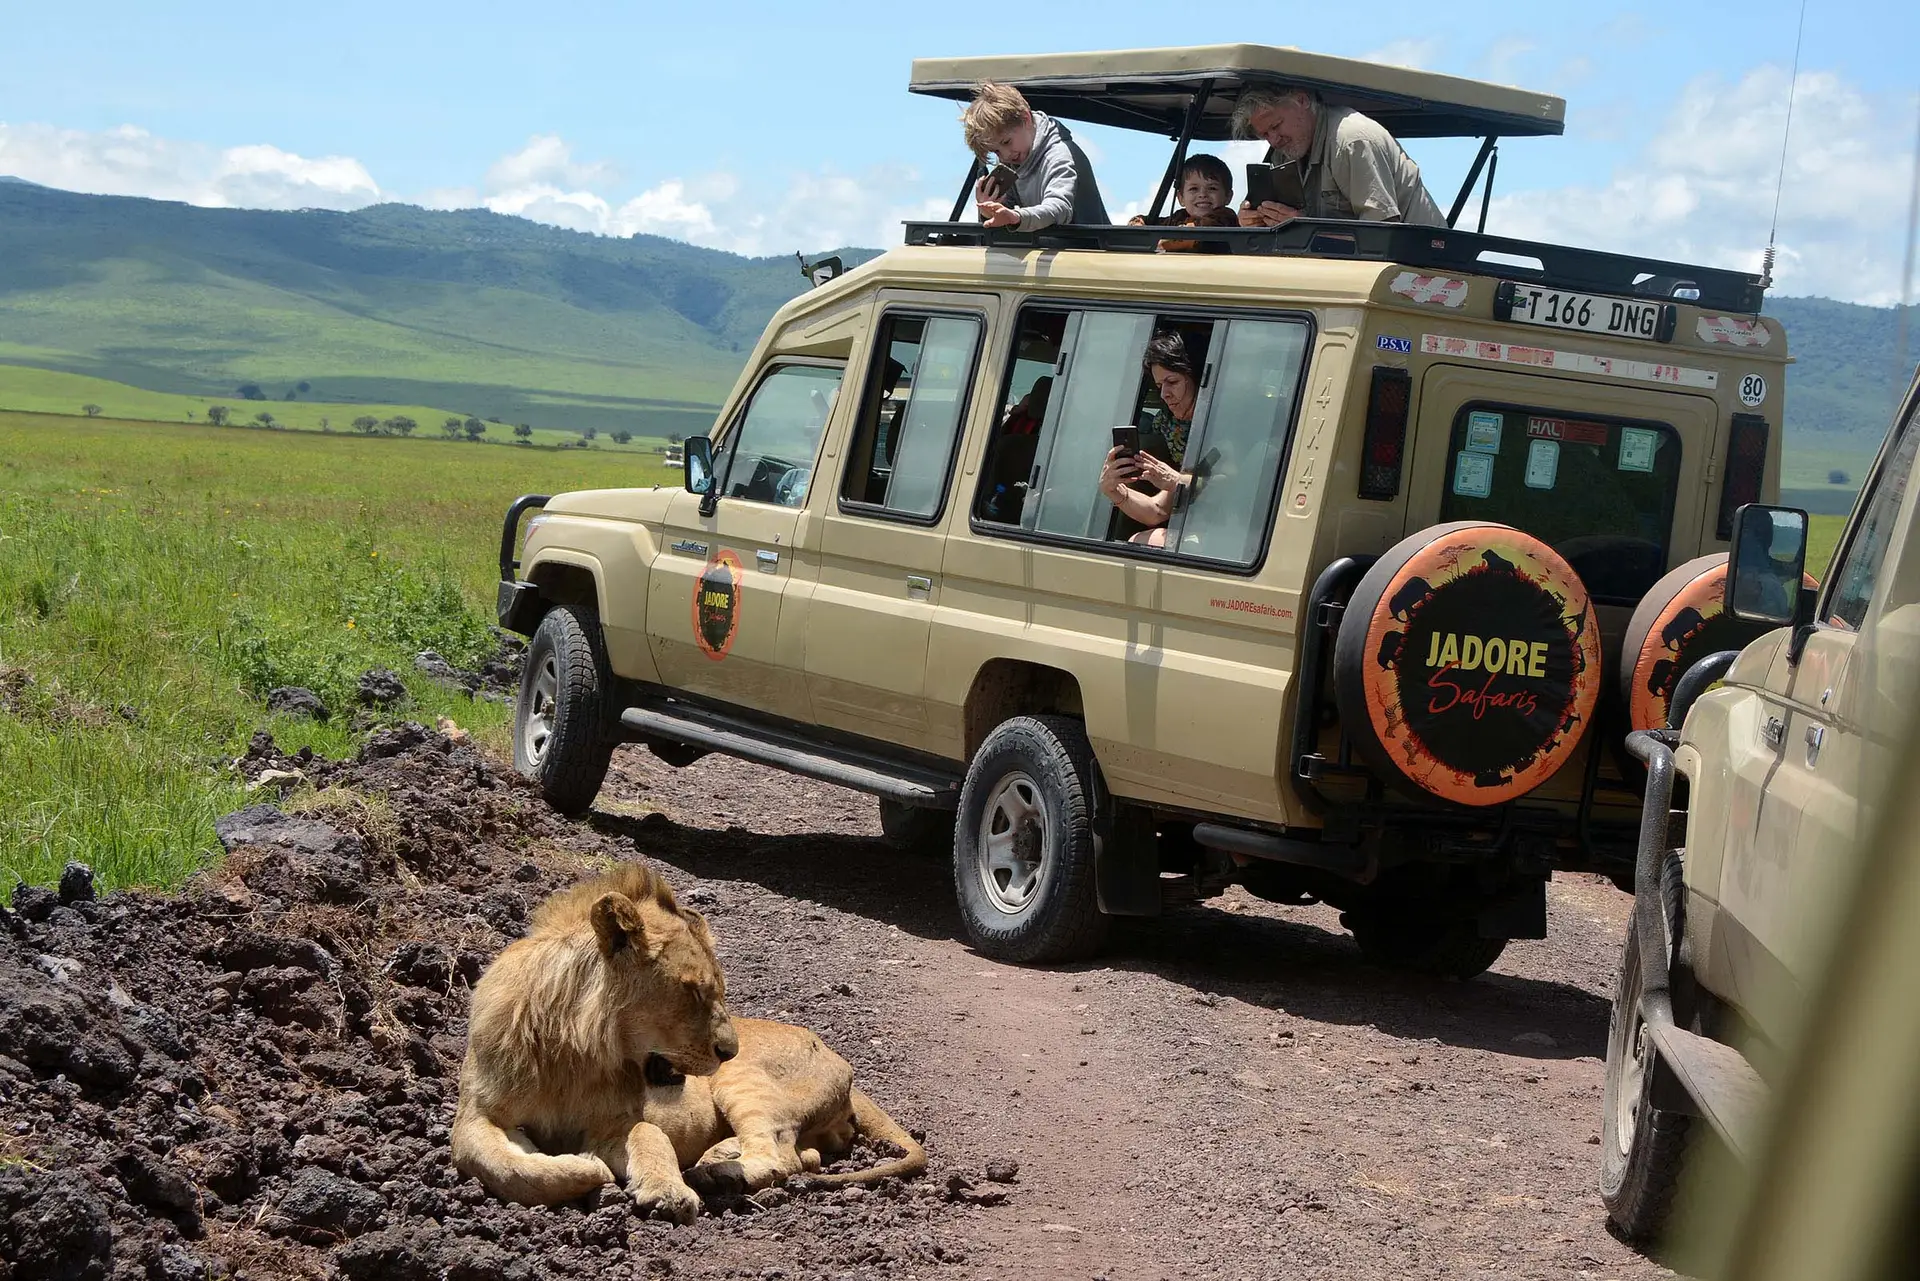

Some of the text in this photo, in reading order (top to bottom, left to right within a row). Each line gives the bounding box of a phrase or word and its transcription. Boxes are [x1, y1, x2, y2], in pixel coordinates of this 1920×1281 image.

[1608, 302, 1655, 336] DNG
[1379, 337, 1410, 352] P.S.V.
[1743, 376, 1763, 397] 80
[1742, 395, 1761, 403] KPH
[704, 591, 729, 609] JADORE
[1426, 631, 1548, 677] JADORE
[1427, 660, 1538, 720] Safaris
